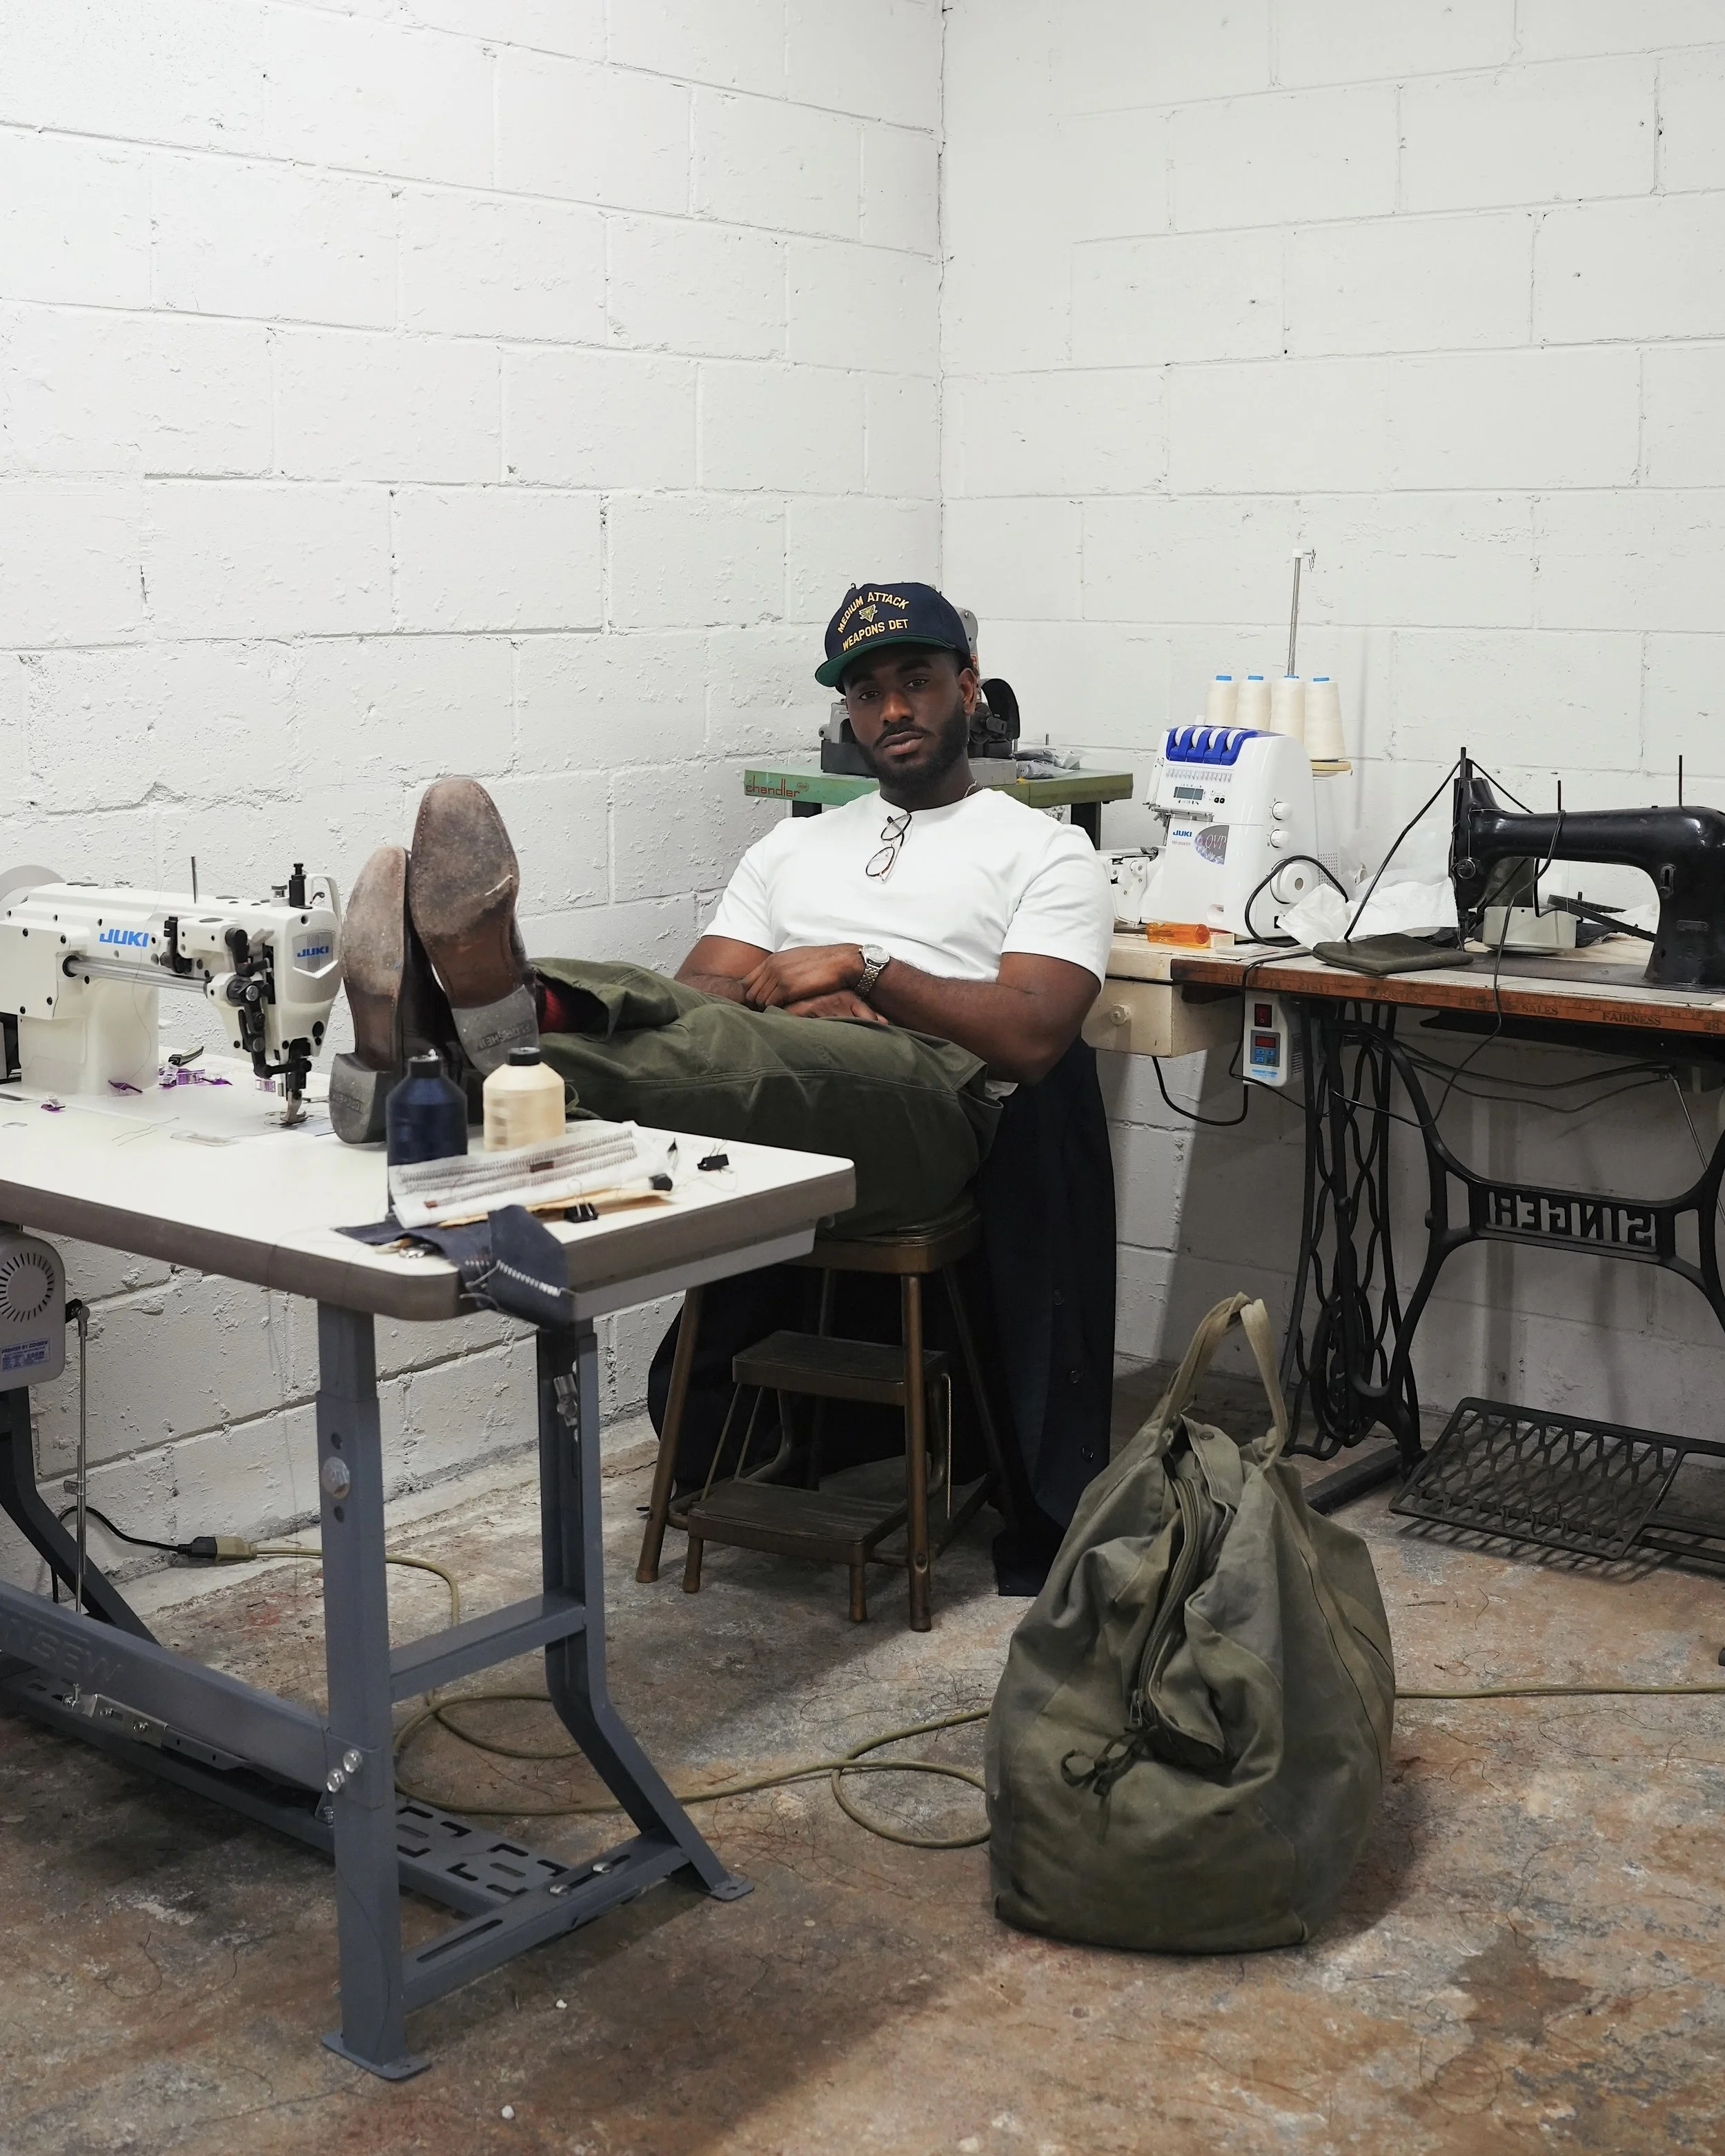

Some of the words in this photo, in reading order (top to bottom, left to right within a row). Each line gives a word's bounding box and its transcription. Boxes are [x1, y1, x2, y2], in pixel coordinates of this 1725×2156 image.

[837, 595, 864, 633] MEDIUM
[867, 591, 909, 610] ATTACK
[842, 621, 885, 651] WEAPONS
[888, 619, 909, 631] DET
[746, 775, 800, 798] chandler
[1205, 834, 1227, 849] QVP
[99, 929, 149, 947] JUKI
[297, 946, 329, 958] JUKI
[1521, 1003, 1559, 1016] SALES
[1602, 1011, 1662, 1026] FAIRNESS
